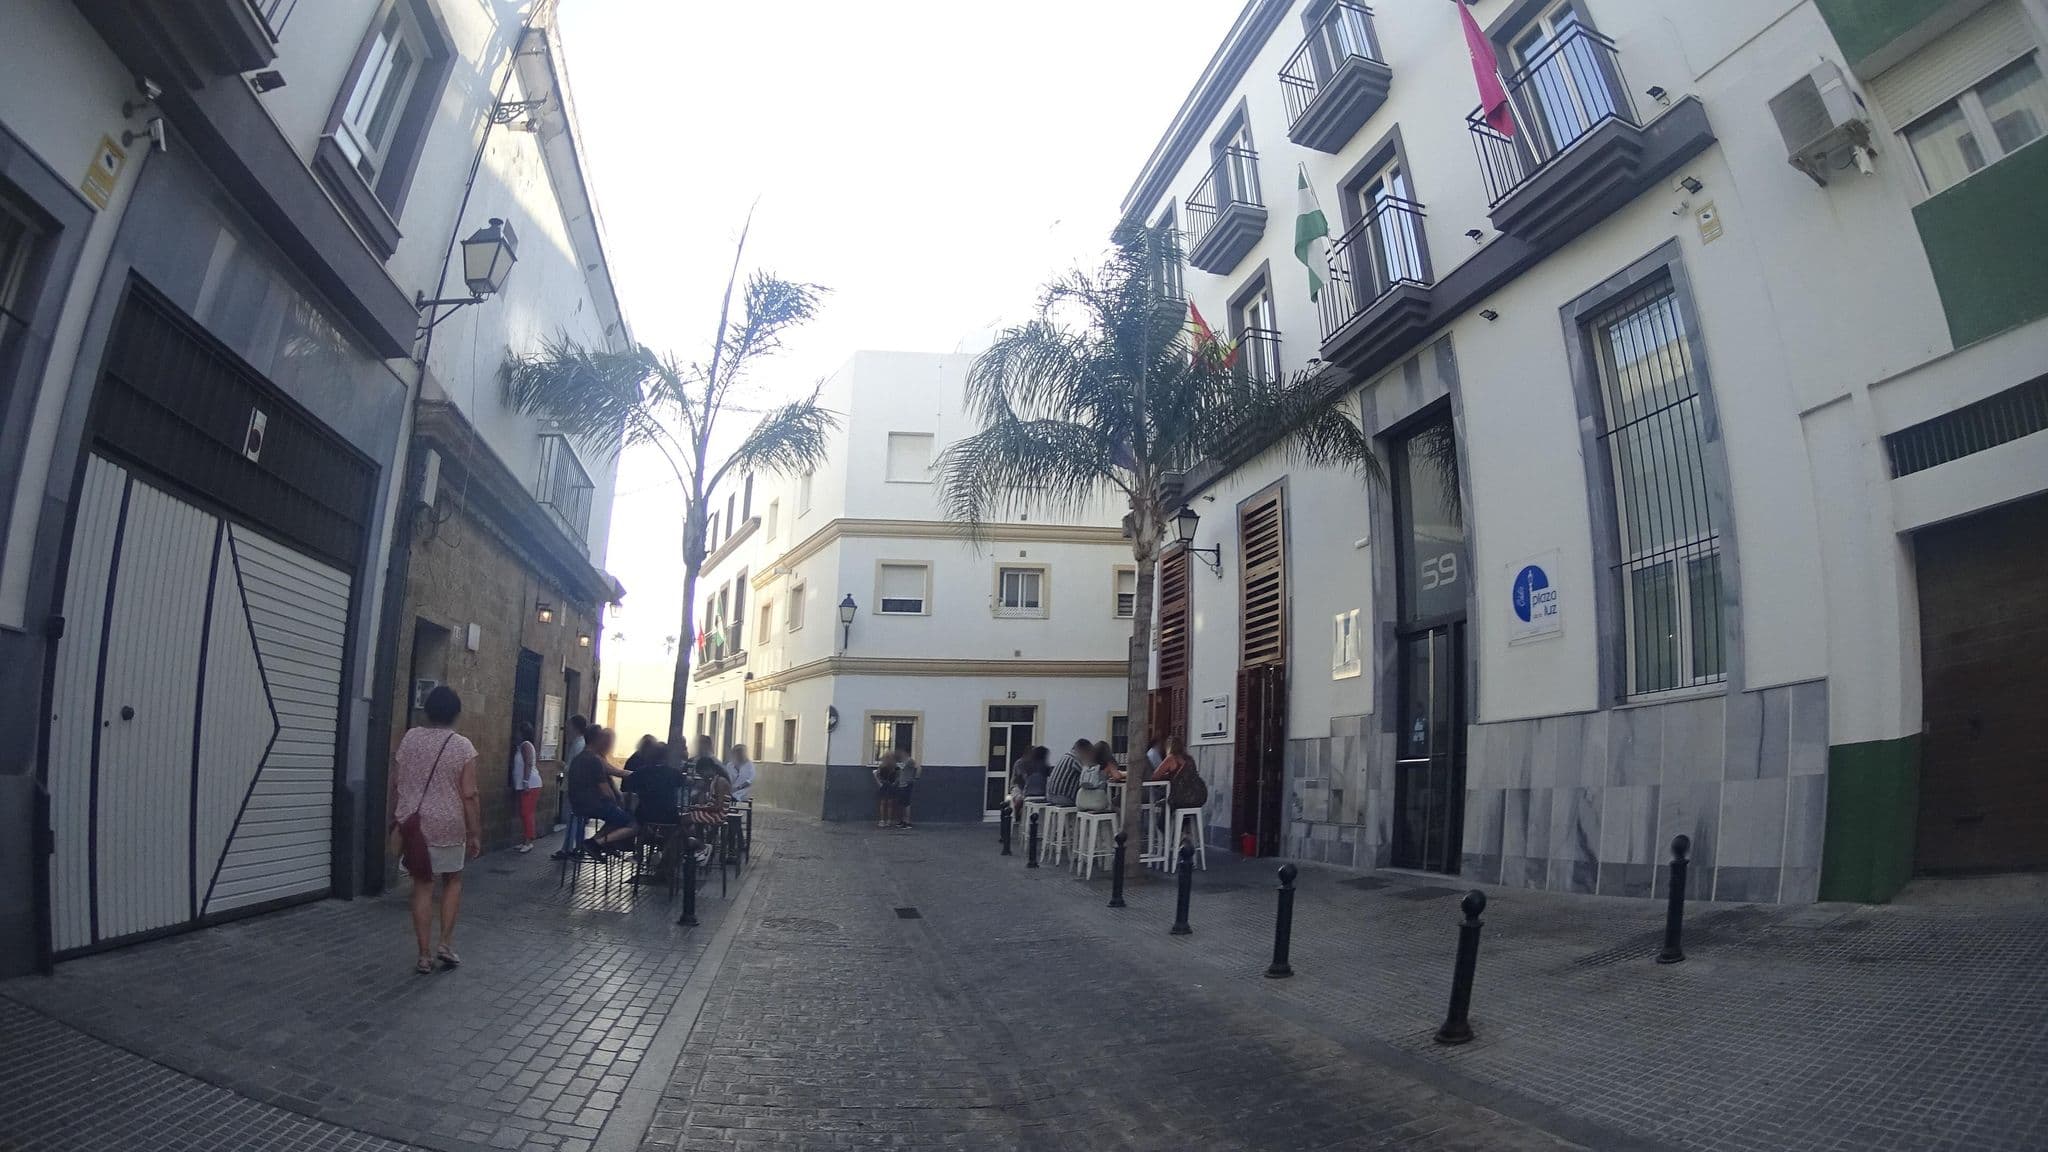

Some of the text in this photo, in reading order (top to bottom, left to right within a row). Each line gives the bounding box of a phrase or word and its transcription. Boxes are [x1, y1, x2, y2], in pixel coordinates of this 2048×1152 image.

[1421, 552, 1457, 590] 59
[1532, 590, 1557, 607] plaza
[1007, 691, 1017, 699] 15
